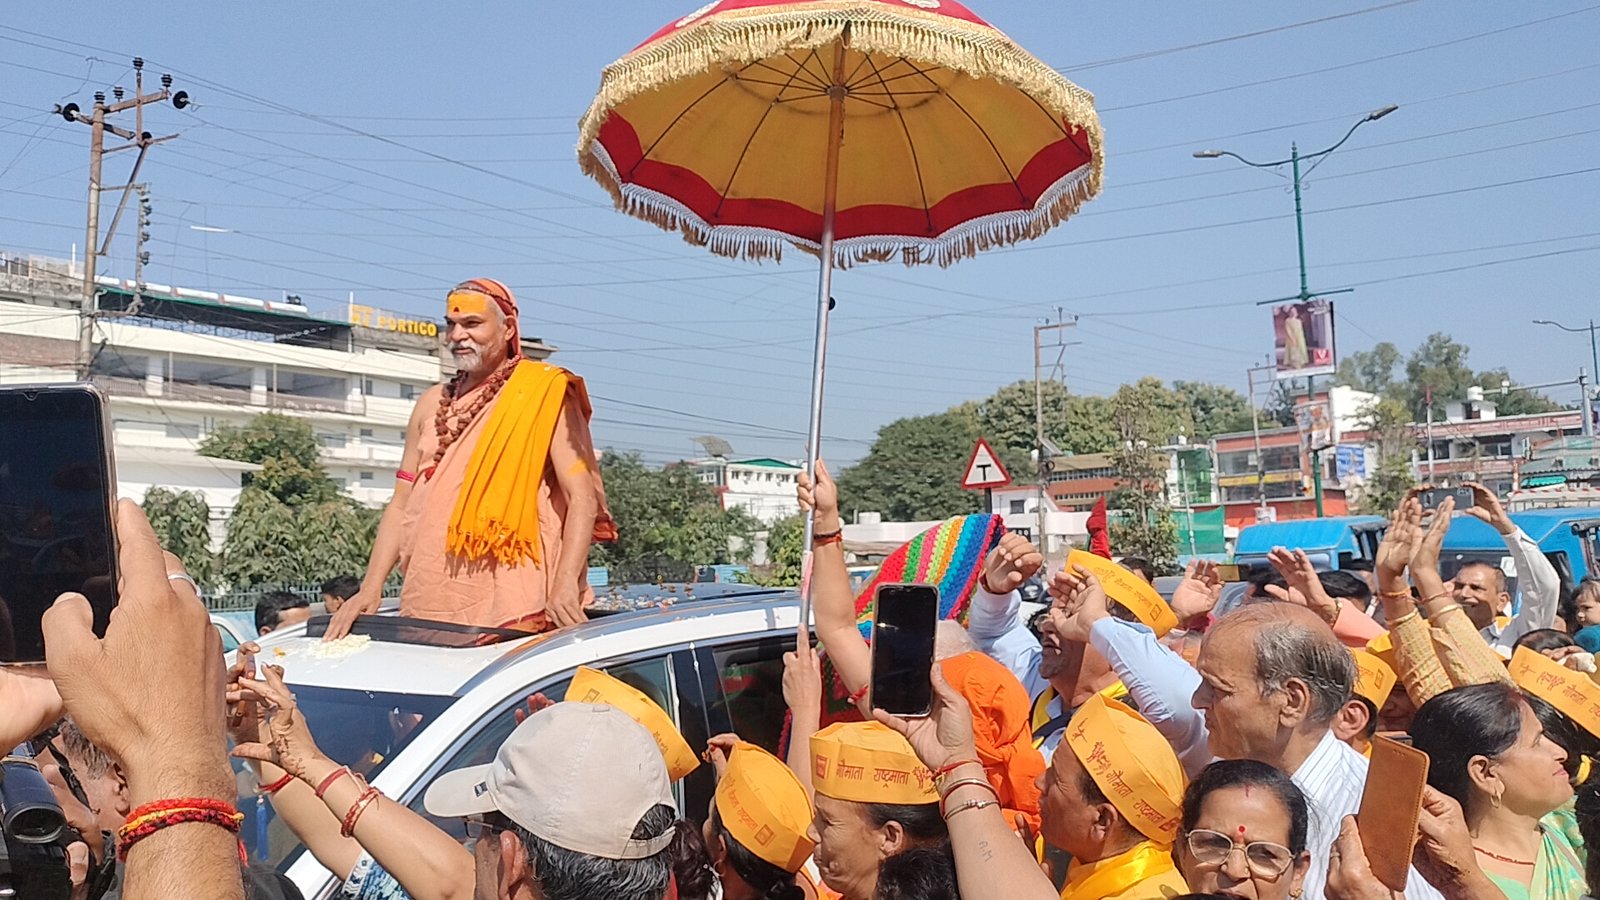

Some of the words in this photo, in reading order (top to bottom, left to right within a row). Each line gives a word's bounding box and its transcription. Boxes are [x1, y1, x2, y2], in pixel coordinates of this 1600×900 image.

[378, 315, 437, 337] PORTICO
[836, 758, 864, 781] गौमाता
[1106, 769, 1134, 798] गौमाता
